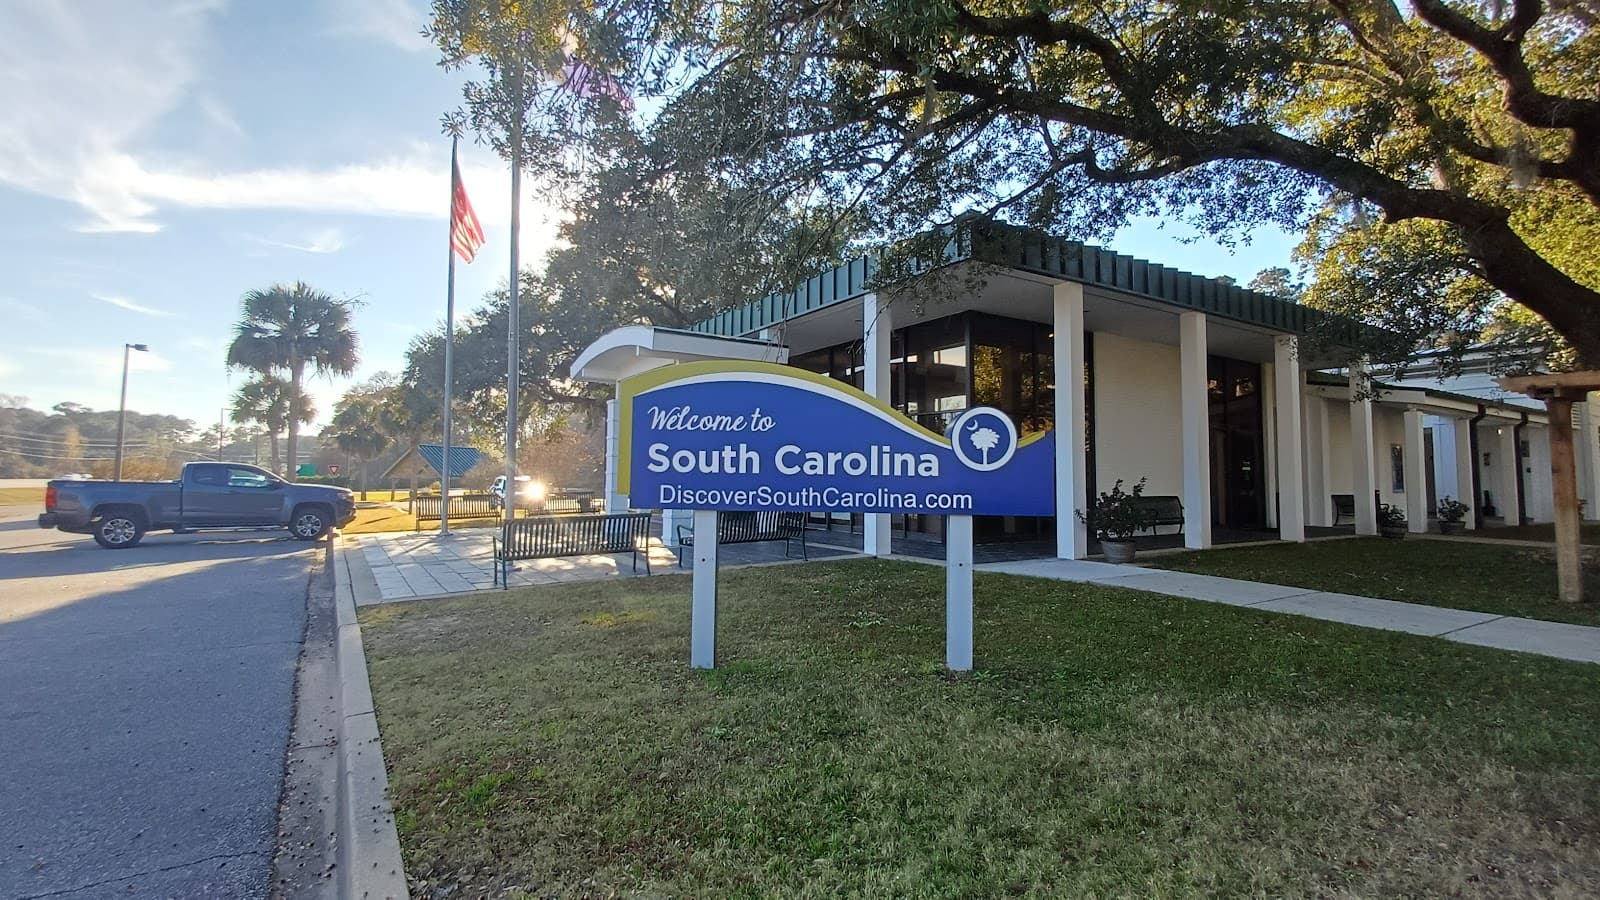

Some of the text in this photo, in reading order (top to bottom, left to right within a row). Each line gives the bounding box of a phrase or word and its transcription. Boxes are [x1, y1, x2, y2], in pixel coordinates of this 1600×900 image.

[647, 405, 776, 432] Welcome to
[647, 443, 940, 477] South Carolina
[659, 484, 973, 509] DiscoverSouthCarolina.com
